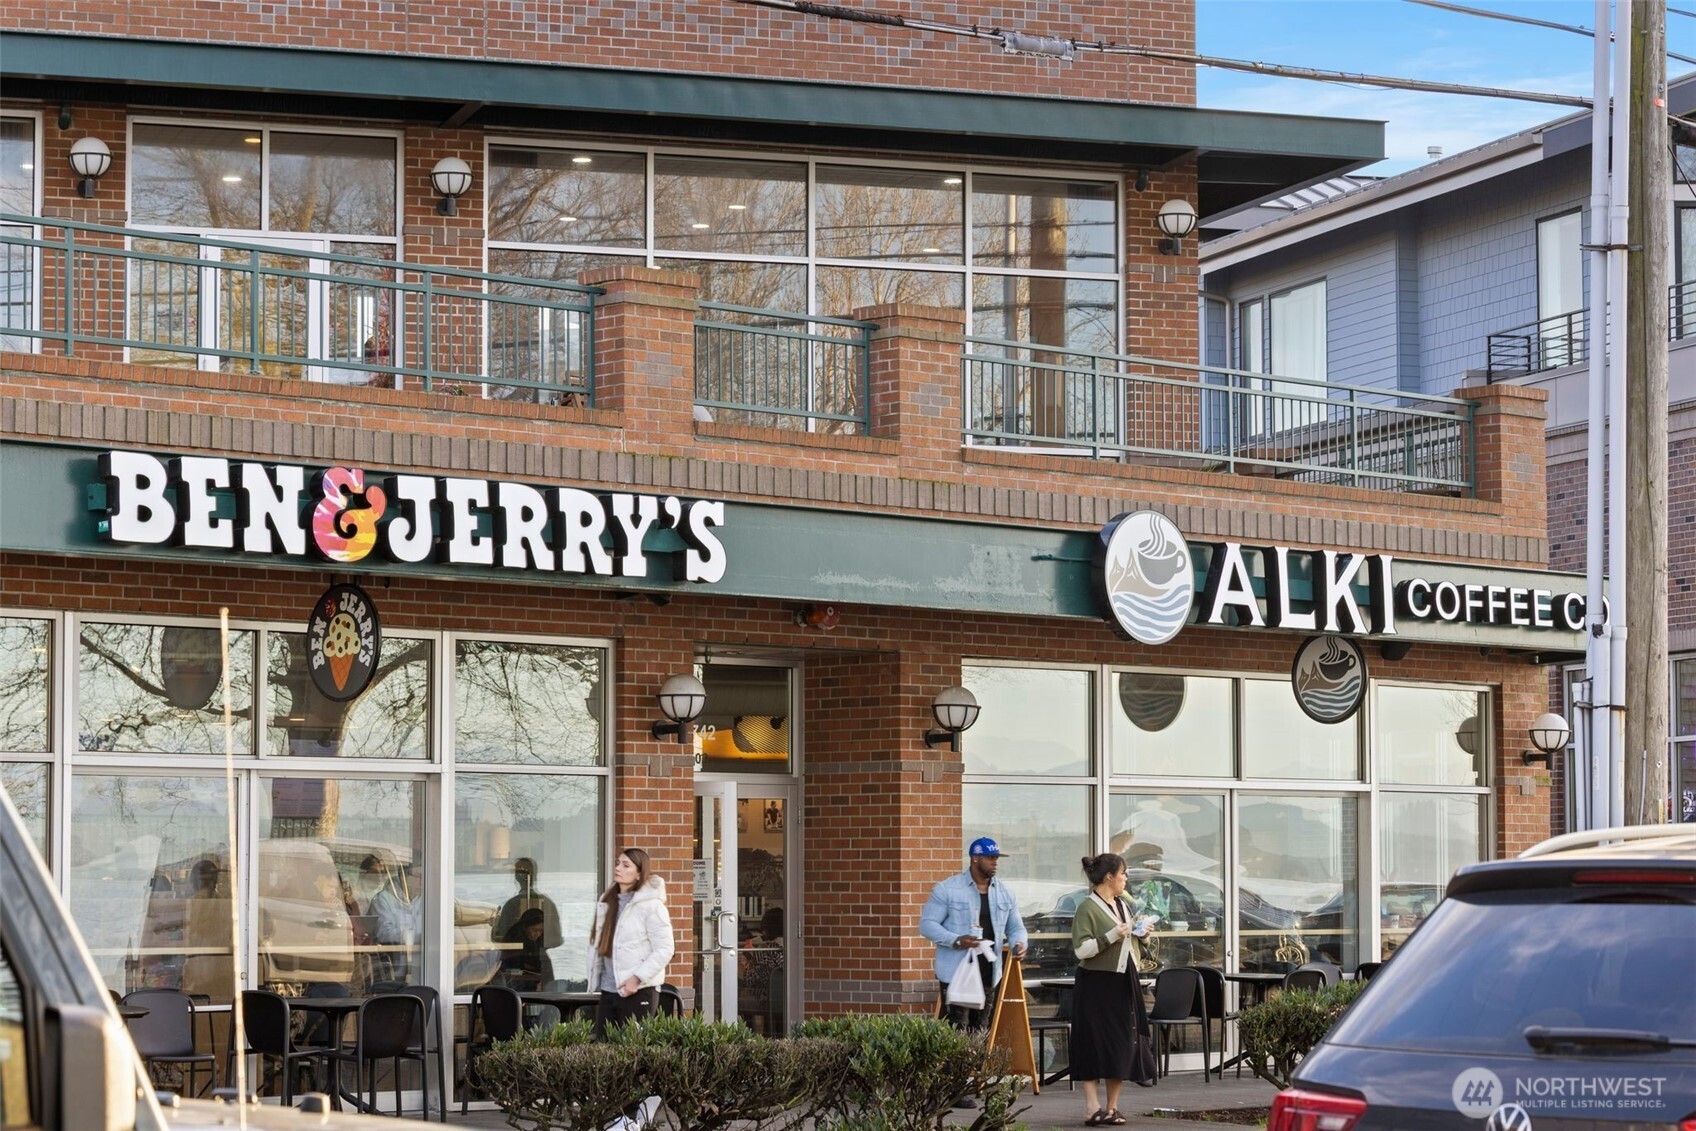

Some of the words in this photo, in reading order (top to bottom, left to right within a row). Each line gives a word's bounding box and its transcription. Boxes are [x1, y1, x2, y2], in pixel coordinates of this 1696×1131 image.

[111, 450, 305, 555] BEN
[312, 466, 387, 563] &
[388, 474, 727, 584] JERRY'S
[311, 616, 327, 670] BEN
[340, 592, 374, 667] JERRY'S
[1208, 542, 1398, 634] ALKI
[1407, 577, 1553, 627] COFFEE
